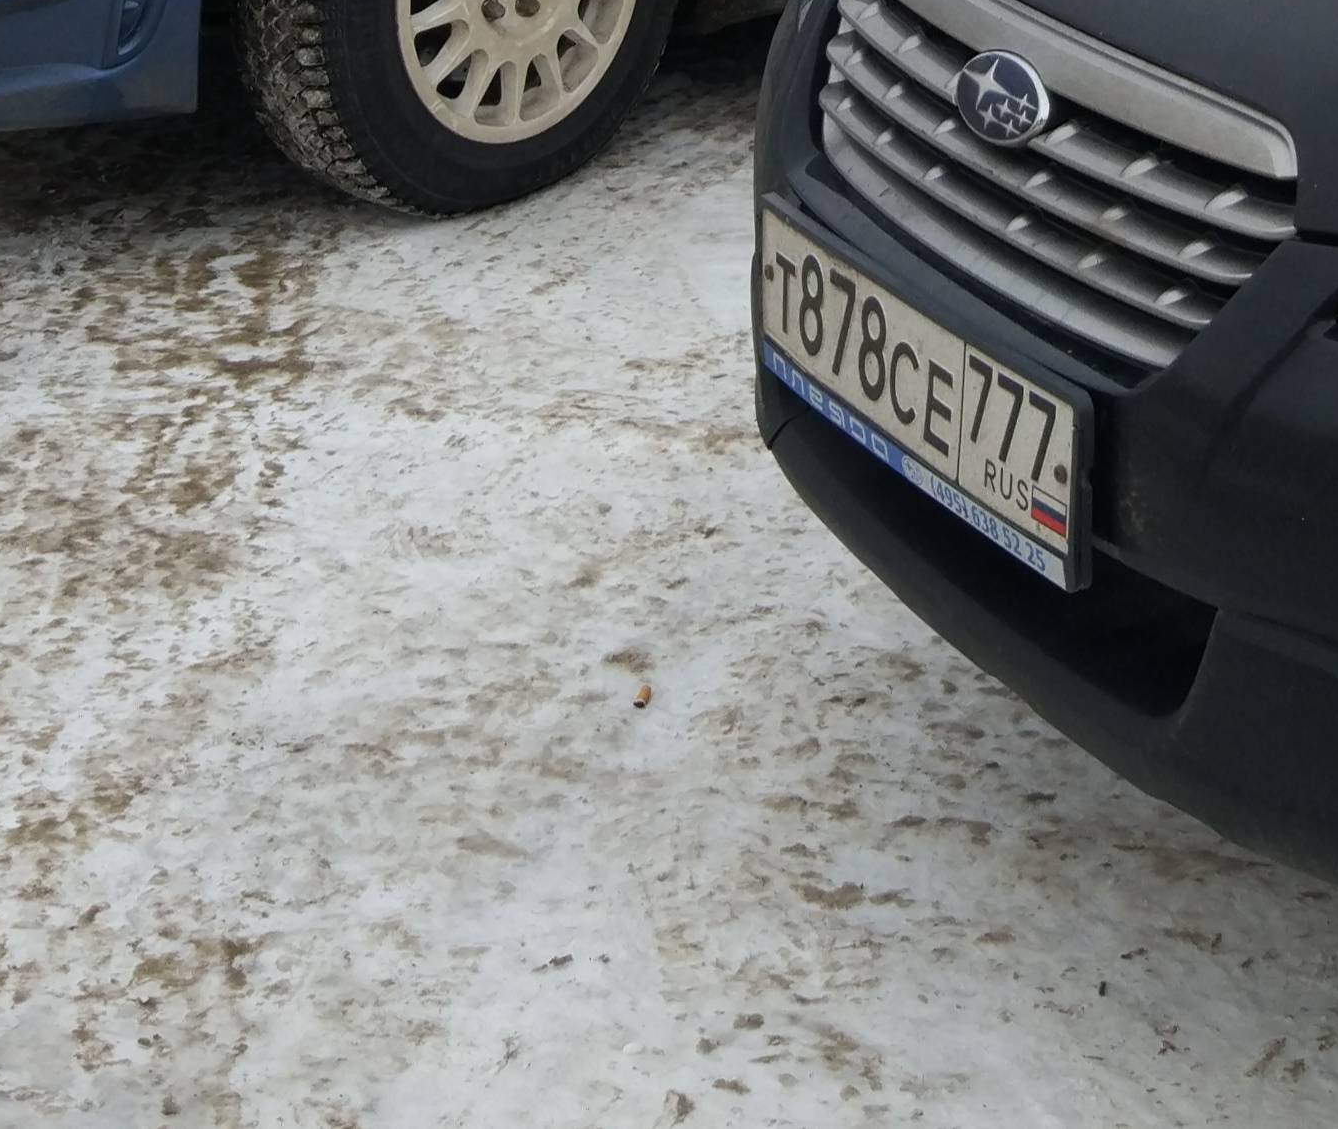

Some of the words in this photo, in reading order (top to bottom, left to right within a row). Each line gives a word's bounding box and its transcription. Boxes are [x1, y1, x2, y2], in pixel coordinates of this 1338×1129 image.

[775, 252, 954, 457] Т878СЕ
[969, 354, 1057, 482] 777
[930, 474, 968, 519] (495)
[971, 505, 998, 540] 638
[1003, 527, 1022, 556] 52
[1026, 541, 1046, 572] 25
[984, 458, 1029, 511] RUS
